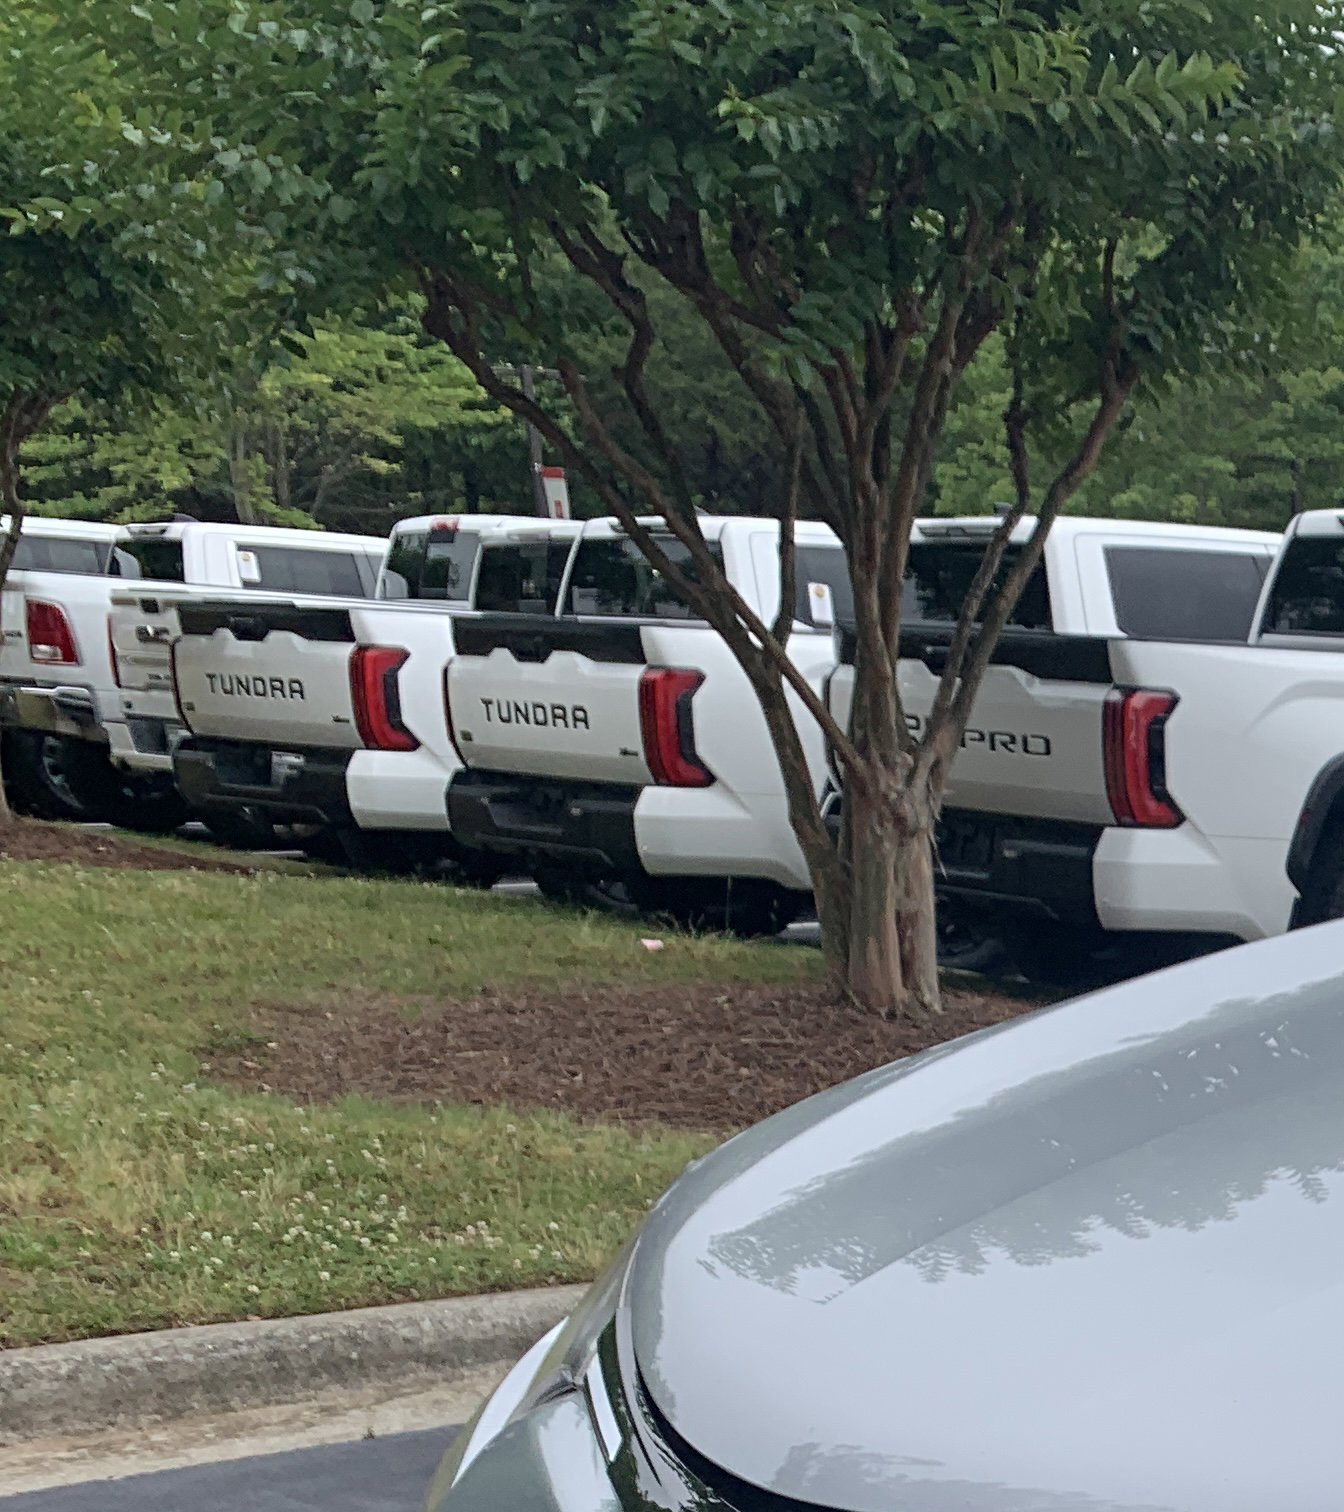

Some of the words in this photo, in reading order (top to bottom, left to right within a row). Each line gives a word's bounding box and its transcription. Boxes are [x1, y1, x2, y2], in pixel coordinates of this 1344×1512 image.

[205, 672, 305, 700] TUNDRA
[480, 697, 590, 730] TUNDRA
[960, 727, 1052, 756] PRO
